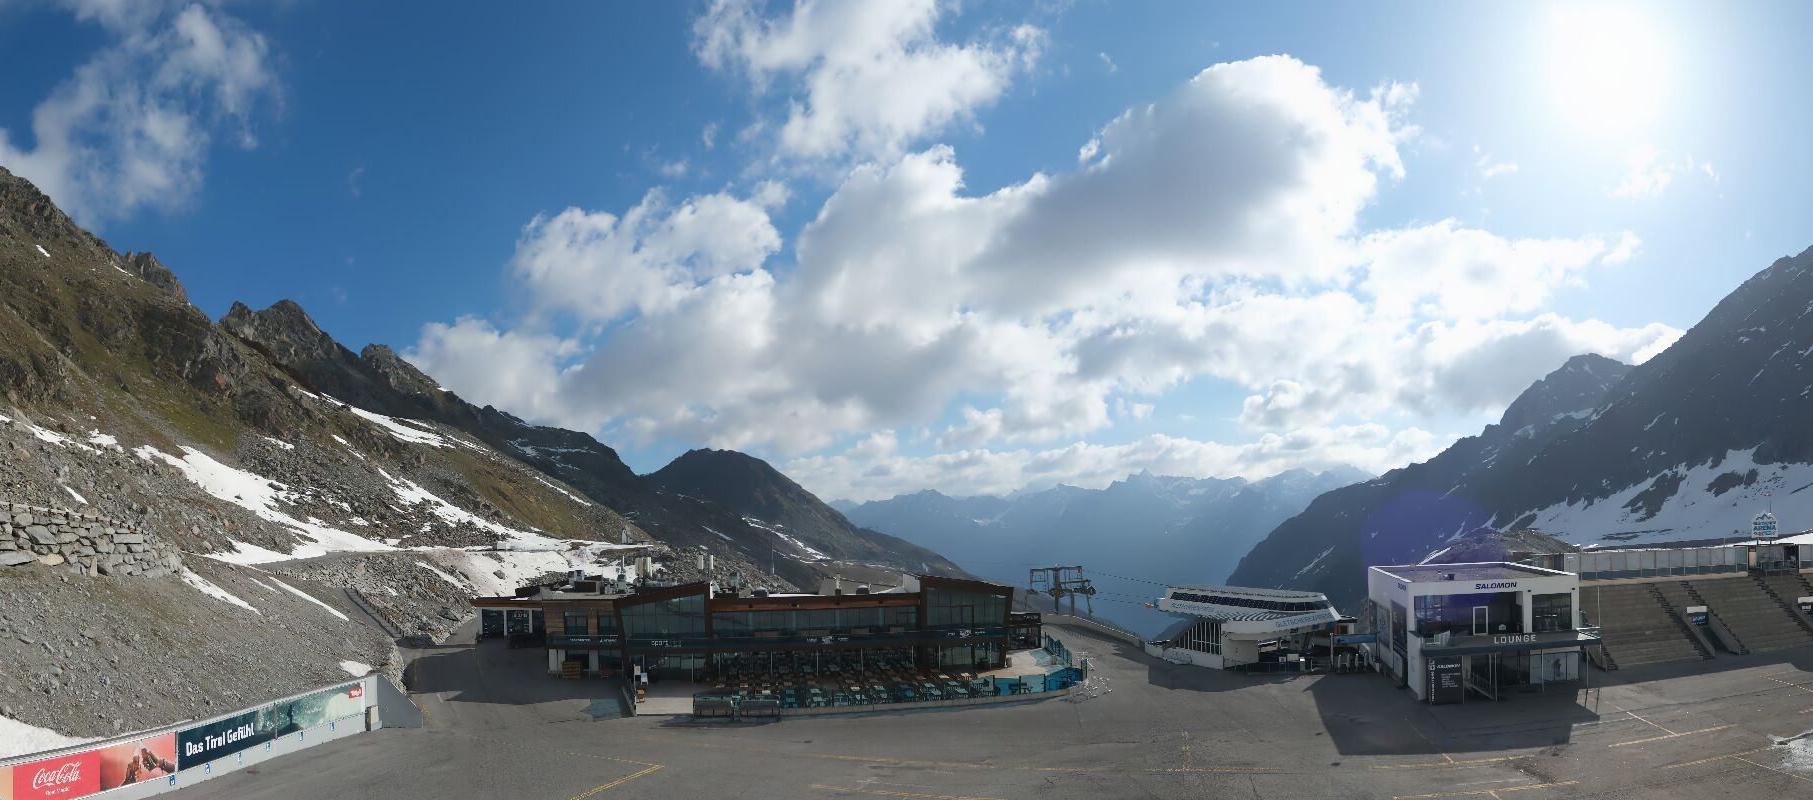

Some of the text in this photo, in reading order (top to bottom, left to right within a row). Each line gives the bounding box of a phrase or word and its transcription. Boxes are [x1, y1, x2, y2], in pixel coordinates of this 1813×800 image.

[1493, 634, 1537, 644] LOUNGE
[185, 722, 255, 756] Das Tirol Gefühl
[32, 761, 83, 789] Coca-Cola
